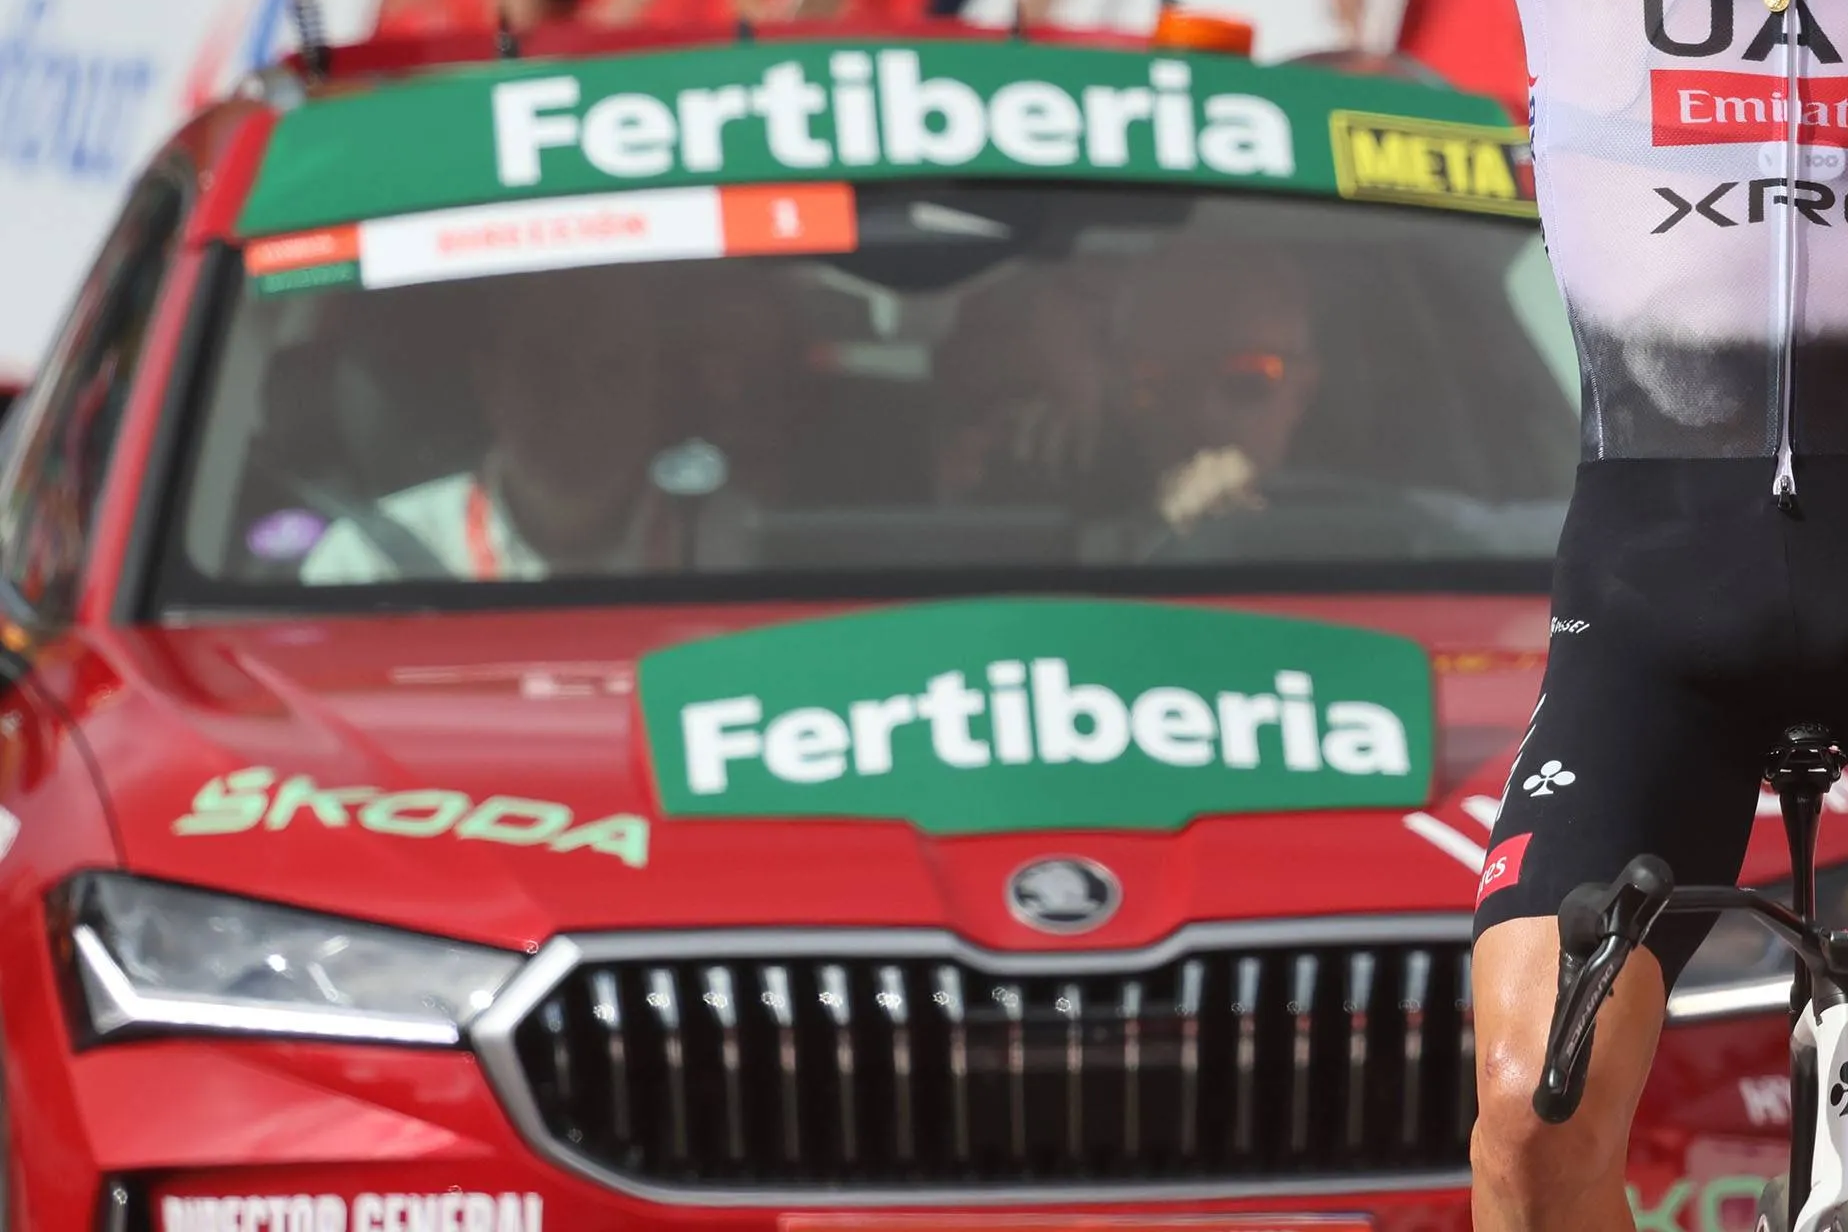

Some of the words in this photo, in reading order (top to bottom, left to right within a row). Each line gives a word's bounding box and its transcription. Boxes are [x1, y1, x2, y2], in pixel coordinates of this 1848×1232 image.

[490, 49, 1296, 188] Fertiberia
[1350, 126, 1521, 199] META
[681, 656, 1411, 795] Fertiberia
